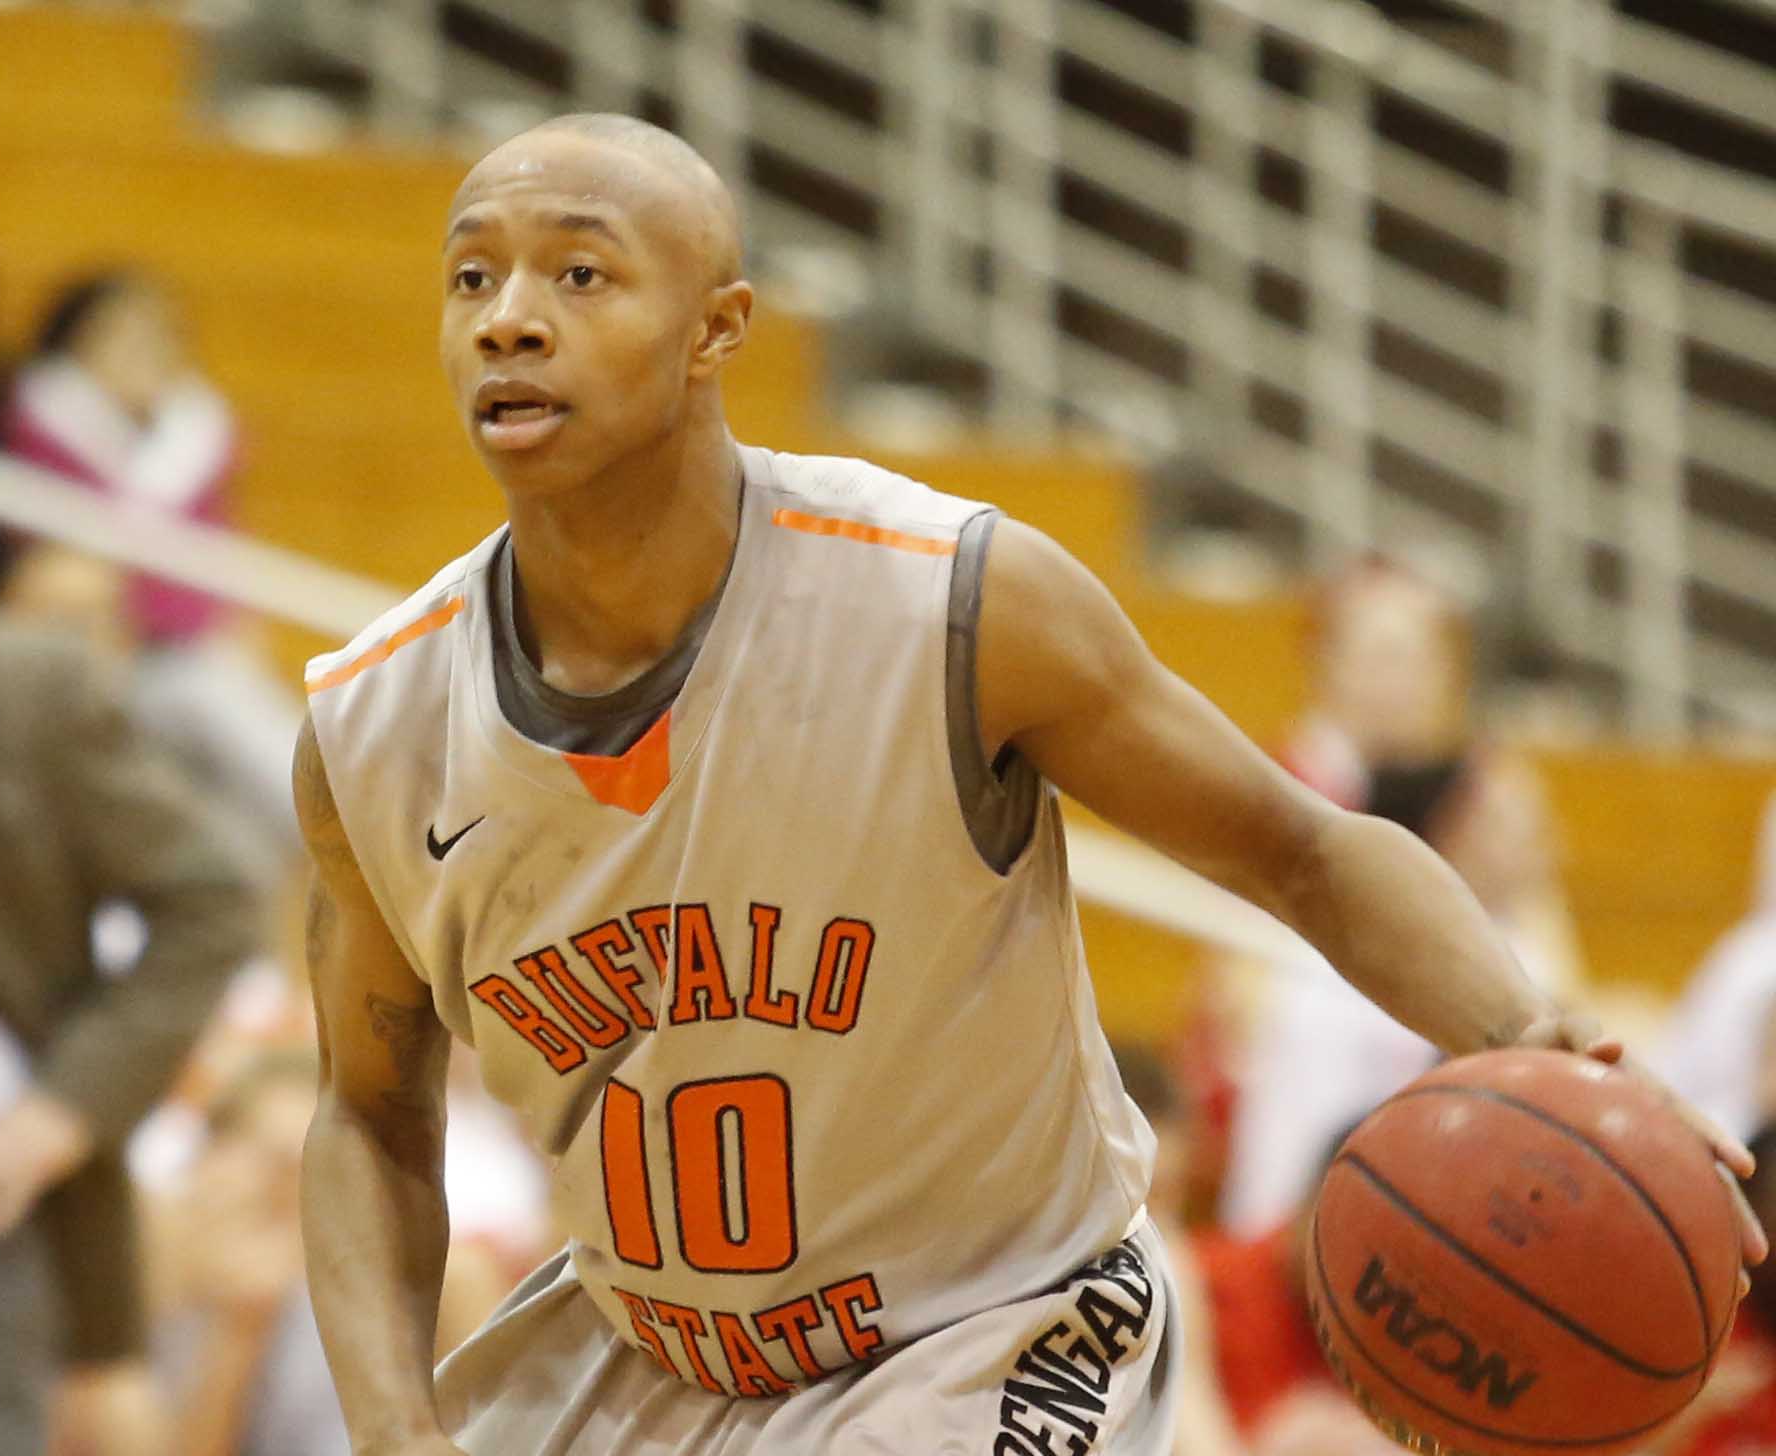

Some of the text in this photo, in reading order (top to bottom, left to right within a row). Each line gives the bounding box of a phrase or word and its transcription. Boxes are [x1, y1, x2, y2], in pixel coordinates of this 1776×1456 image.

[468, 902, 876, 1076] BUFFALO
[600, 1072, 798, 1276] 10
[610, 1272, 884, 1400] STATE
[1354, 1254, 1540, 1410] NCAA
